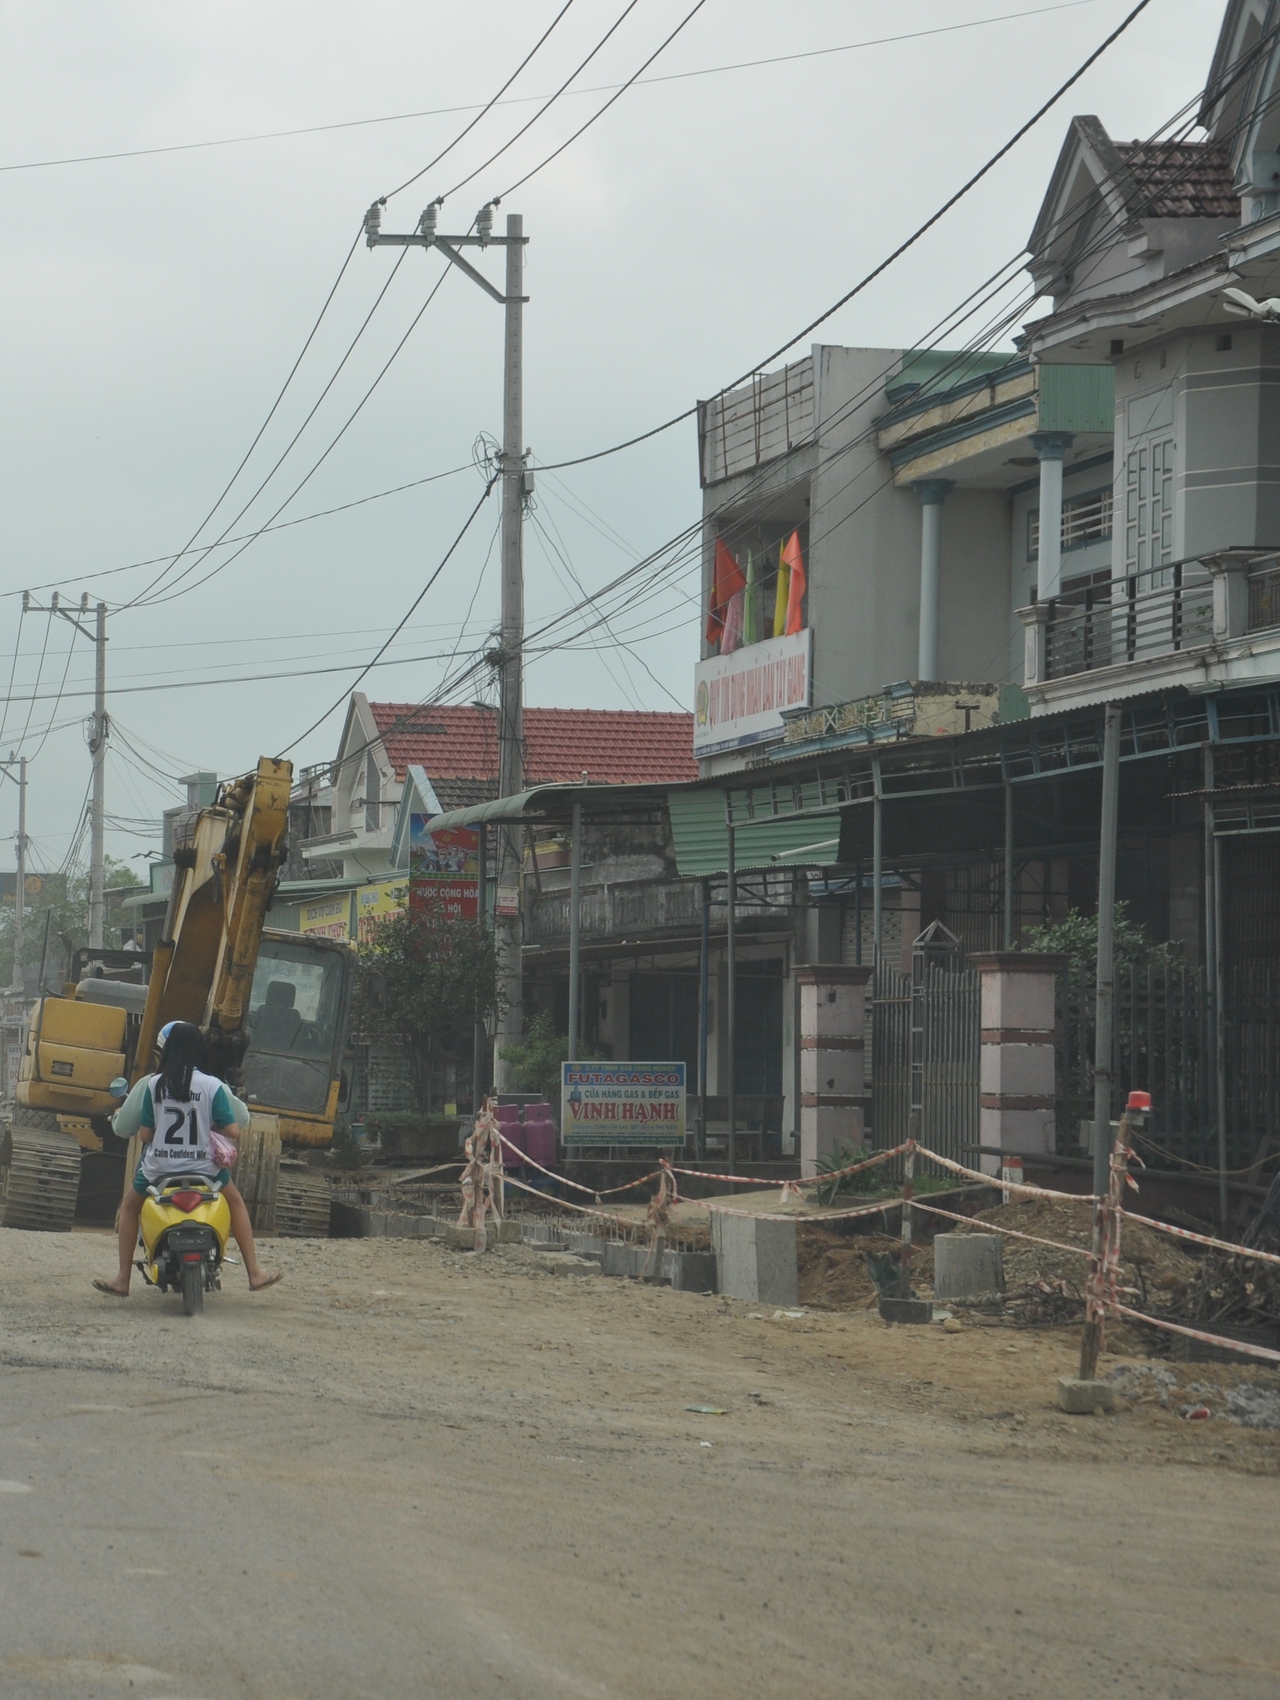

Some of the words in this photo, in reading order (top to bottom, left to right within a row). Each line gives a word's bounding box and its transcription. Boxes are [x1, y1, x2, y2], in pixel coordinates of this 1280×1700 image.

[440, 887, 461, 900] CỘNG
[567, 1072, 680, 1085] FUTAGASCO
[584, 1086, 600, 1099] CỬA
[601, 1088, 622, 1099] HÀNG
[624, 1090, 639, 1099] GAS
[641, 1090, 646, 1099] &
[649, 1087, 662, 1099] BẾP
[664, 1090, 680, 1099] GAS
[569, 1102, 620, 1121] VINH
[621, 1102, 679, 1124] HẠNH
[164, 1106, 198, 1145] 21
[154, 1148, 168, 1158] Calm
[169, 1148, 195, 1159] Confident
